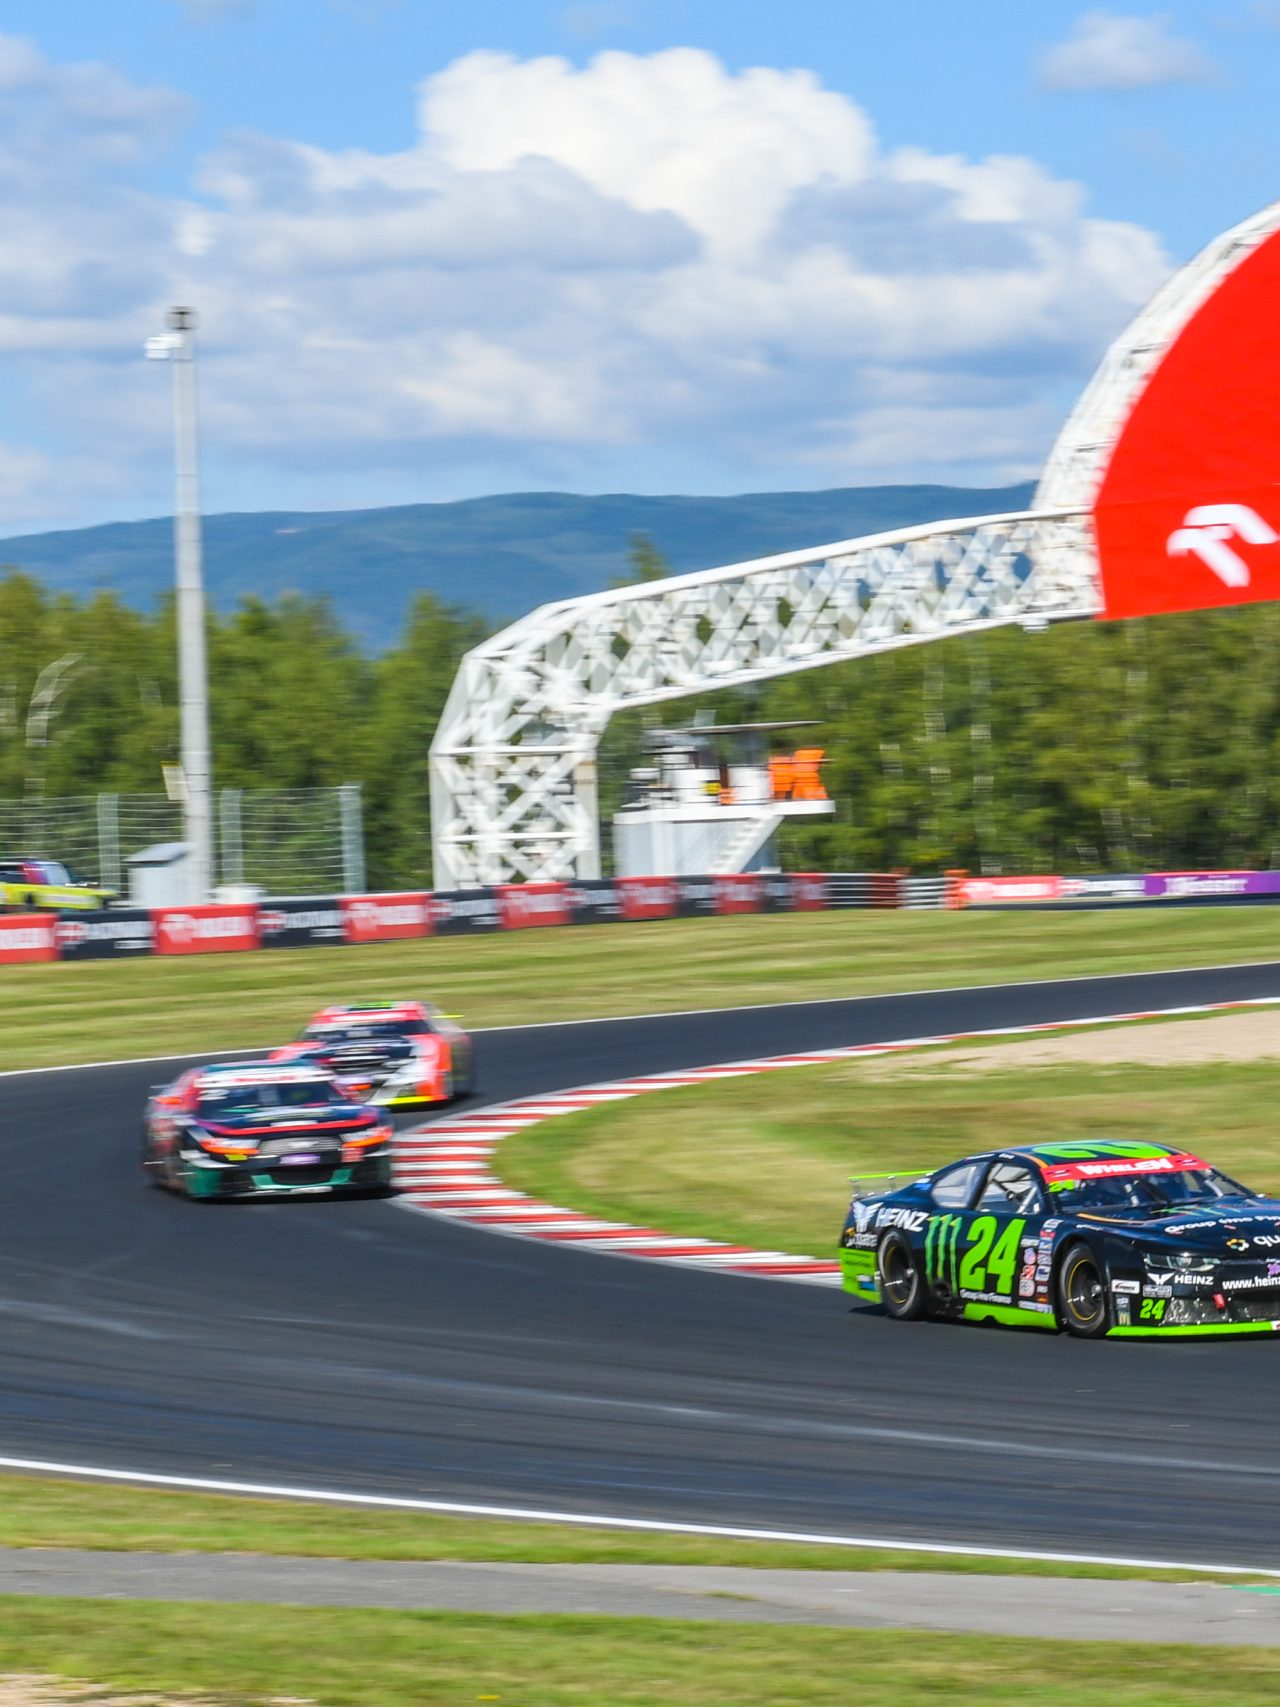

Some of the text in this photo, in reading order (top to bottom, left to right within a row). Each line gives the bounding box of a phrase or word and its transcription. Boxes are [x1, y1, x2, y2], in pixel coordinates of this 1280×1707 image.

[875, 1207, 930, 1232] HEINZ
[1164, 1220, 1216, 1233] Group
[959, 1215, 1027, 1295] 24
[1174, 1274, 1214, 1286] HEINZ
[1139, 1298, 1166, 1319] 24
